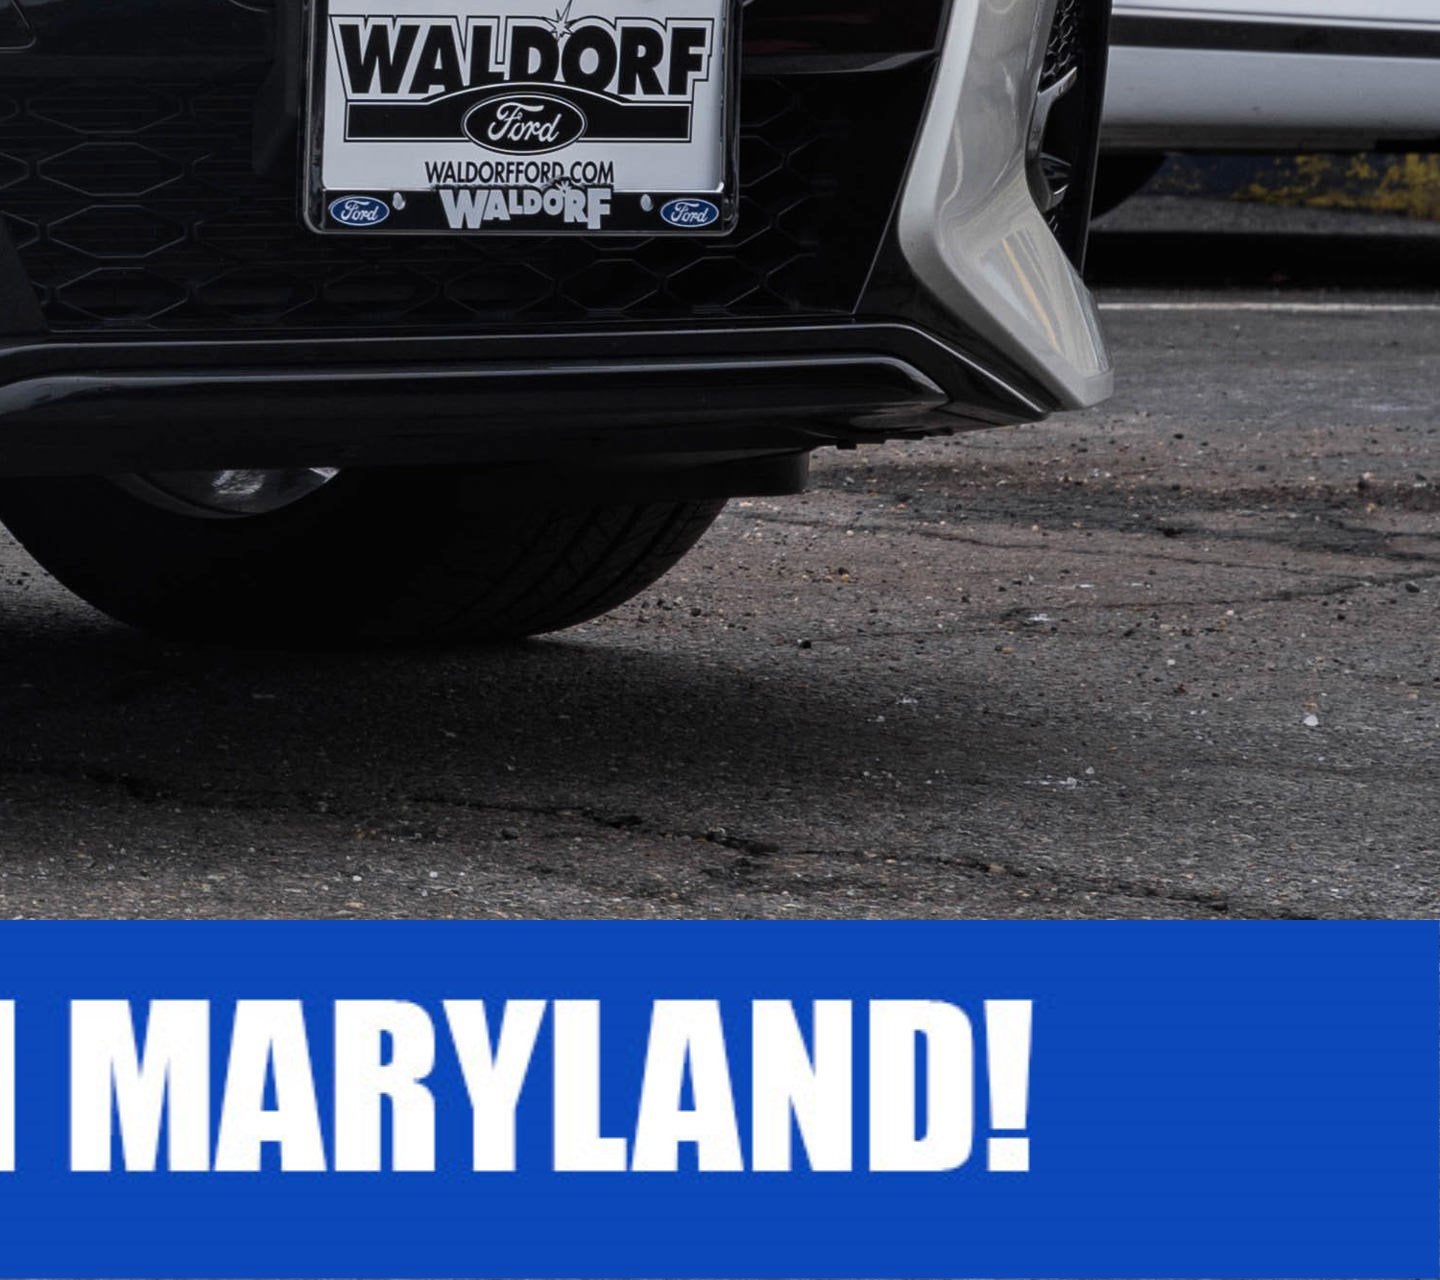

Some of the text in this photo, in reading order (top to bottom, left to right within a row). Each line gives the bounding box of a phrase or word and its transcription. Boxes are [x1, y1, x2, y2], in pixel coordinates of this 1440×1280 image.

[338, 23, 705, 95] WALDORF
[487, 101, 560, 142] Ford
[340, 202, 379, 222] Ford
[439, 188, 611, 229] WALDORF
[670, 204, 709, 224] Ford
